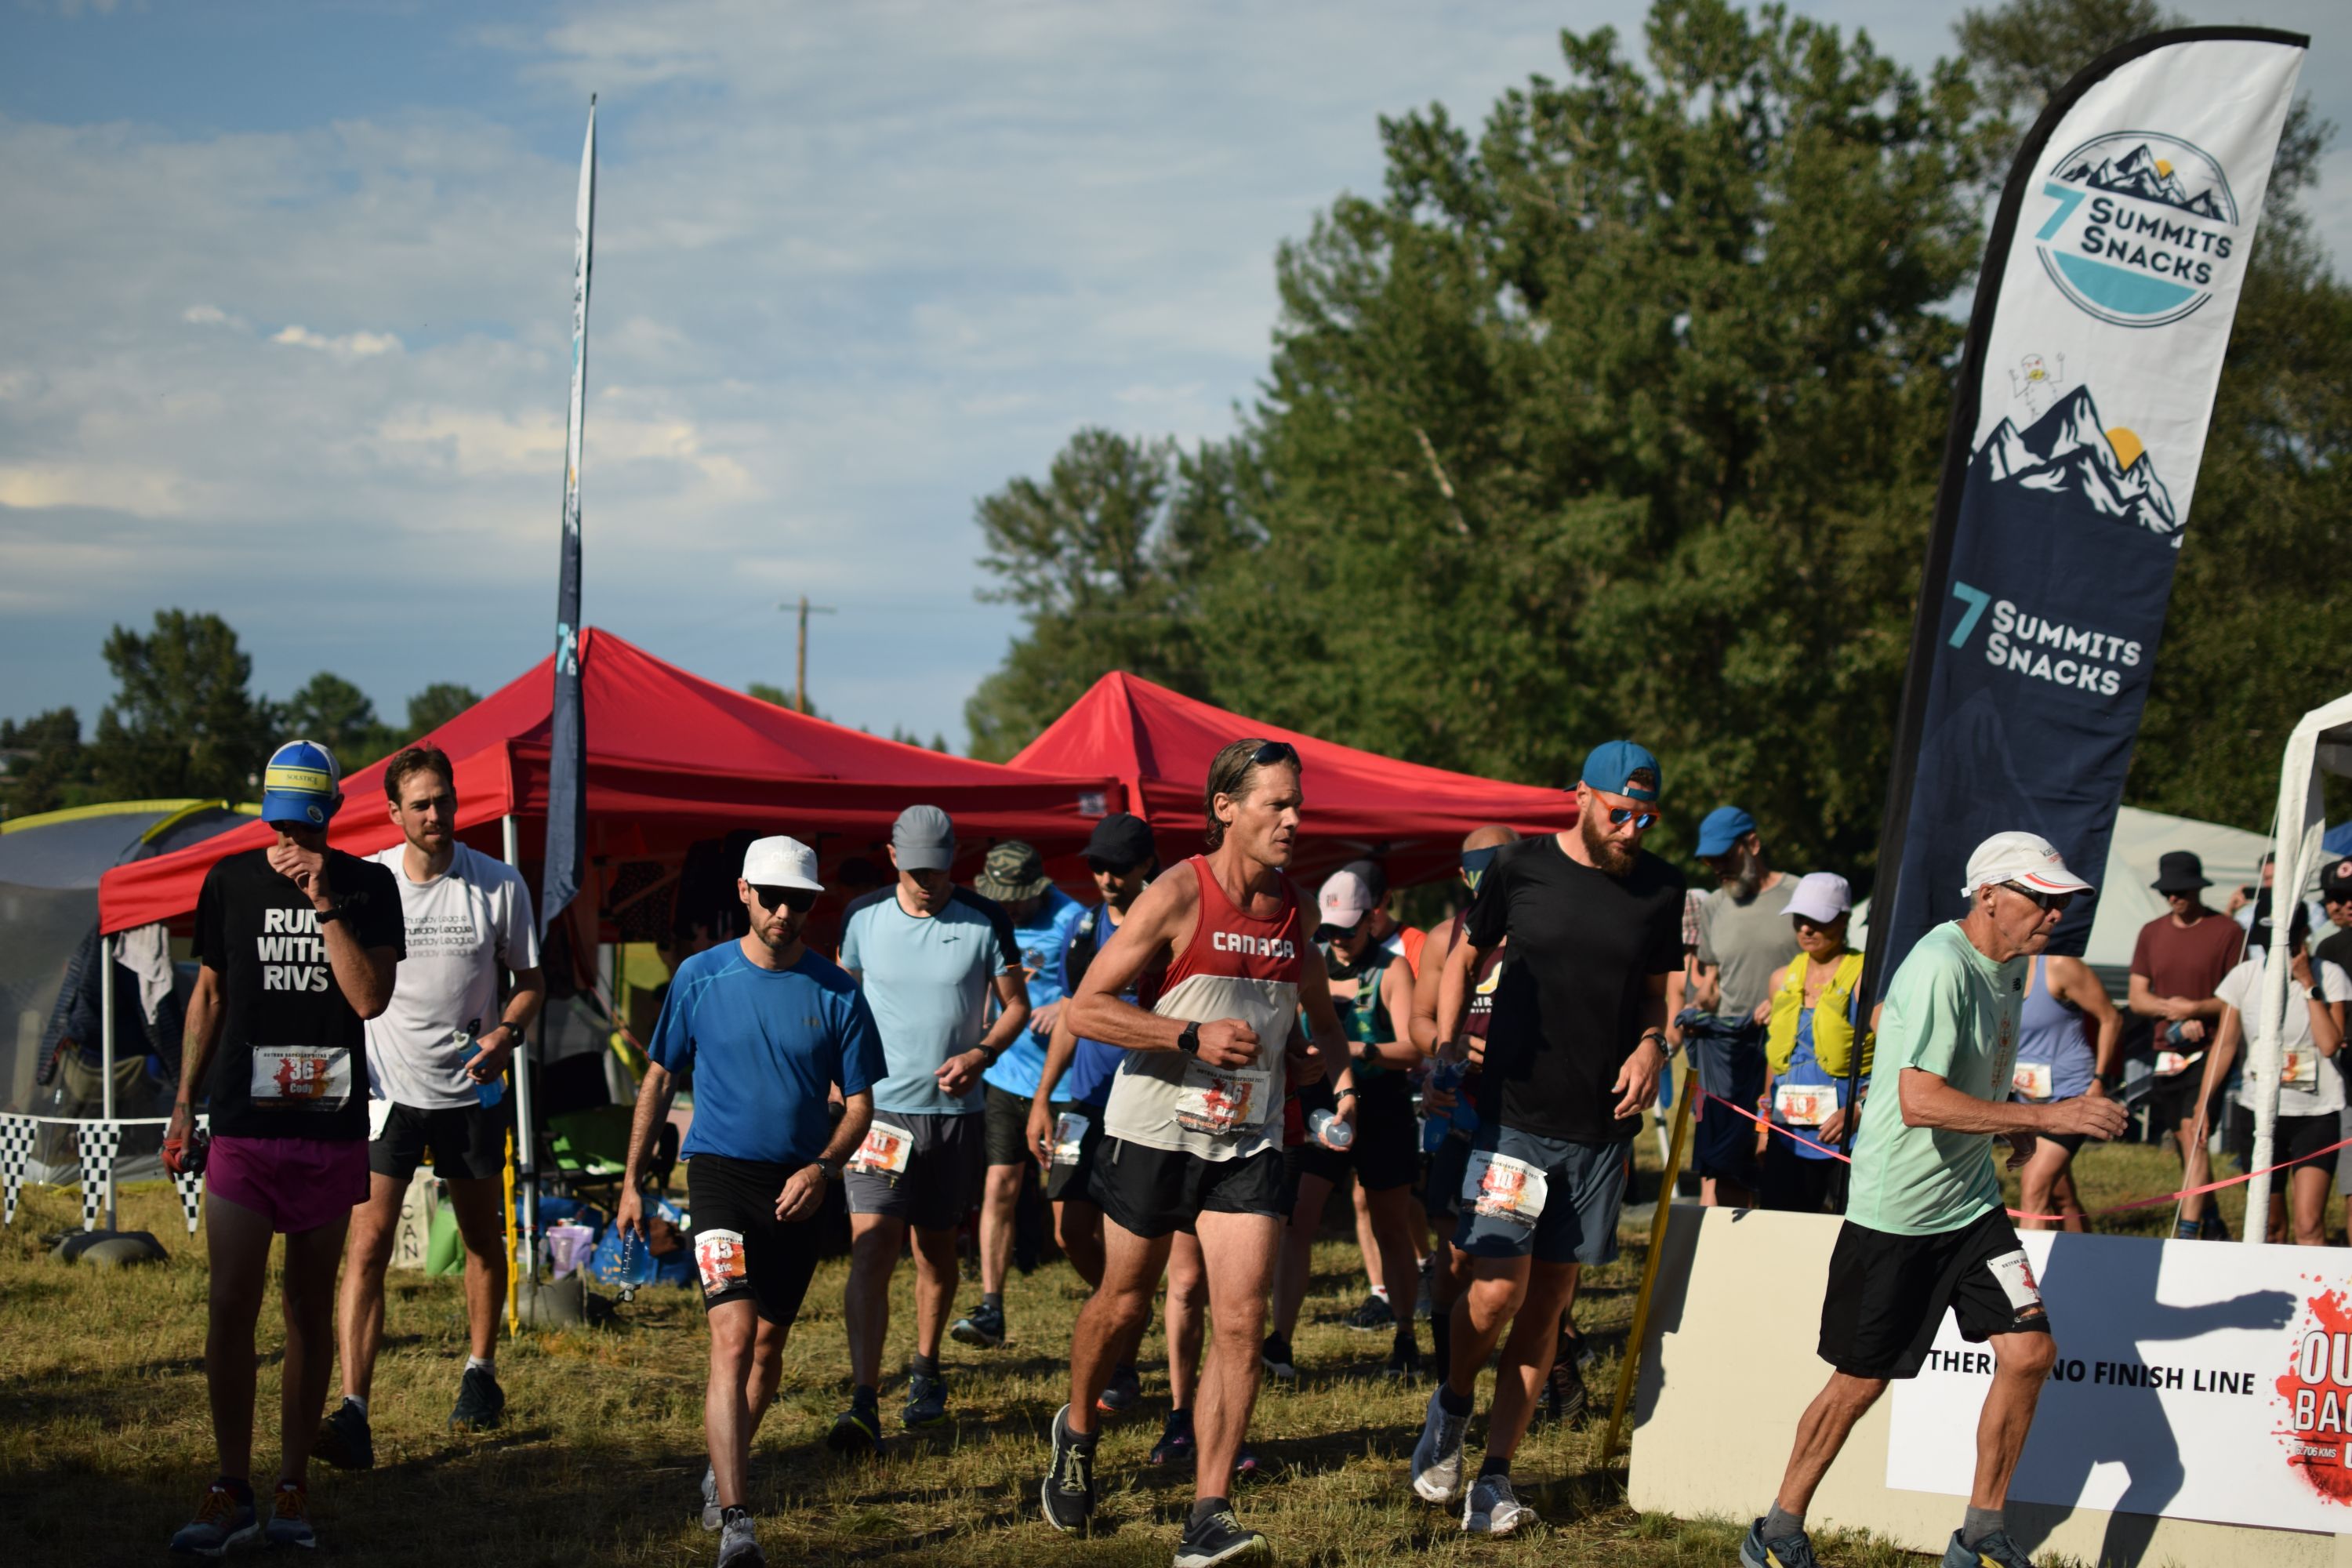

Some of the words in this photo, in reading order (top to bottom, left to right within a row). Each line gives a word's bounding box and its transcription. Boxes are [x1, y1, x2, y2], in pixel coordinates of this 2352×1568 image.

[2034, 181, 2086, 241] 7
[2089, 198, 2233, 259] SUMMITS
[2081, 225, 2212, 285] SNACKS
[1948, 581, 1991, 649] 7
[1991, 600, 2143, 666] SUMMITS
[1986, 632, 2121, 696] SNACKS
[263, 908, 324, 935] RUN
[439, 925, 474, 935] League
[256, 936, 331, 964] WITH
[440, 936, 477, 947] League
[1213, 931, 1295, 959] CANADA
[263, 965, 328, 993] RIVS
[289, 1060, 314, 1080] 36
[289, 1083, 312, 1094] Cody
[710, 1243, 733, 1259] 43
[1928, 1349, 1998, 1375] THER
[2046, 1359, 2086, 1382] NO
[2094, 1361, 2184, 1390] FINISH
[2194, 1369, 2256, 1396] LINE
[2318, 1446, 2336, 1458] KMS
